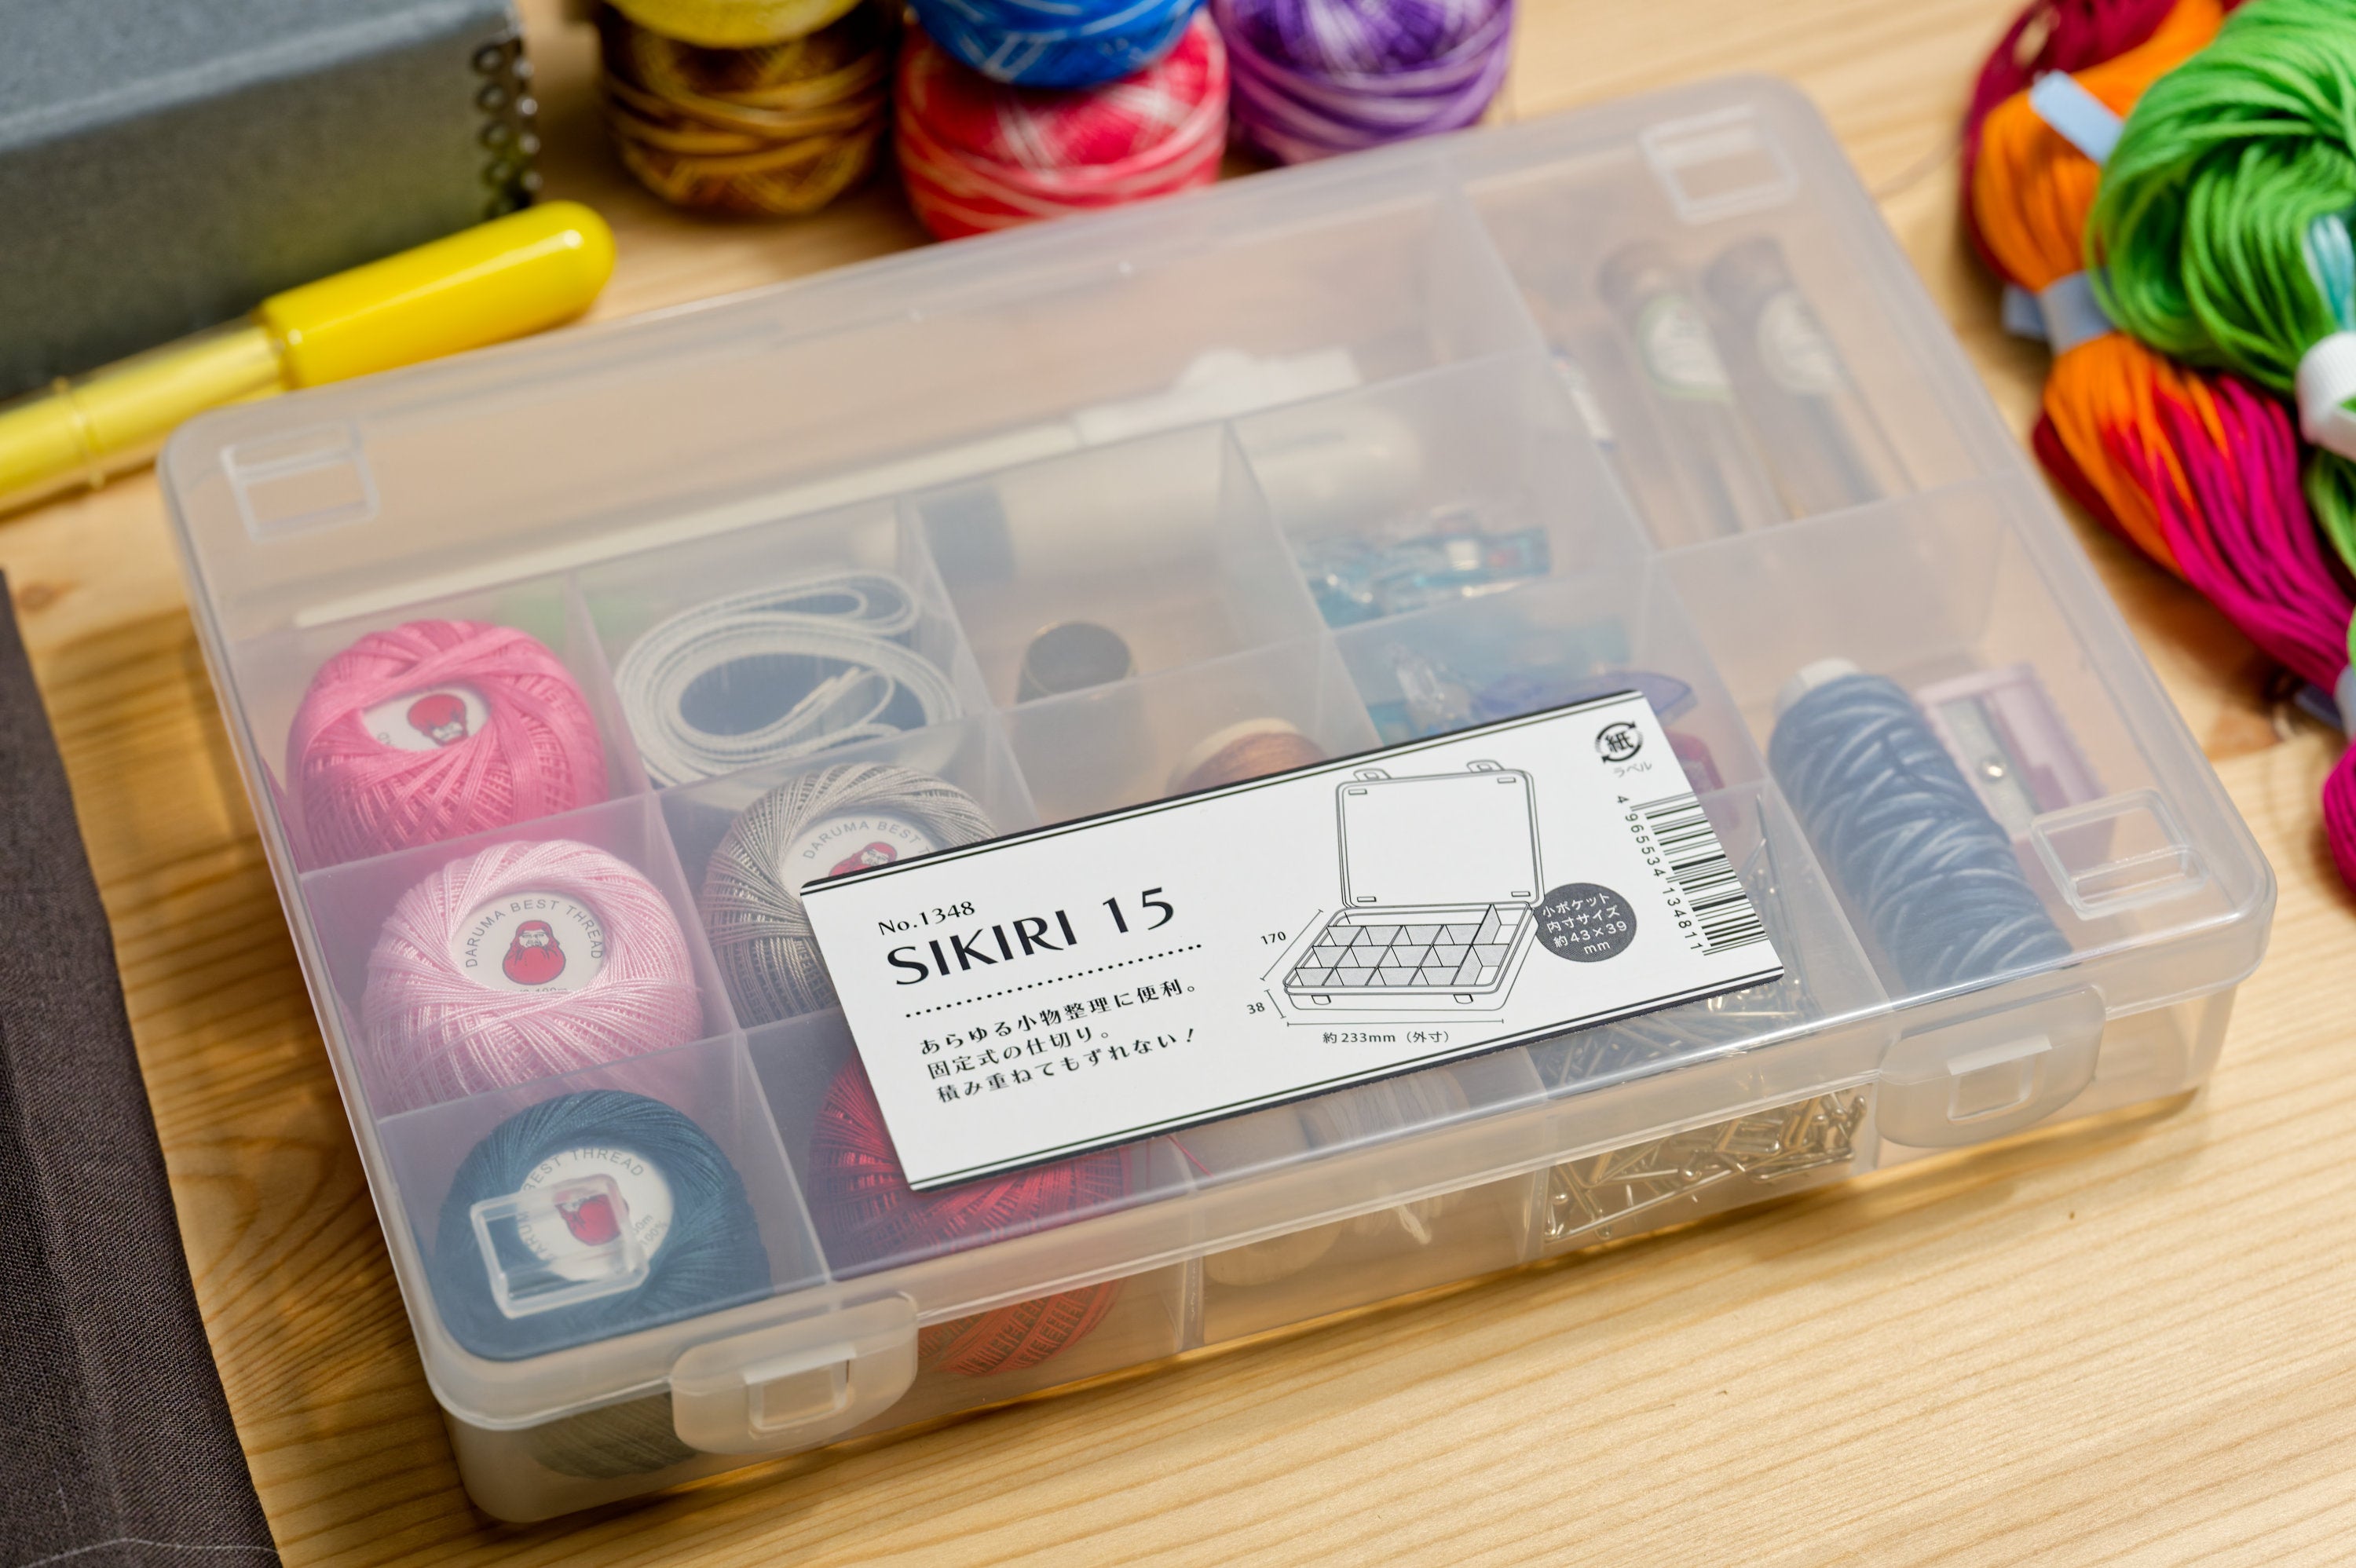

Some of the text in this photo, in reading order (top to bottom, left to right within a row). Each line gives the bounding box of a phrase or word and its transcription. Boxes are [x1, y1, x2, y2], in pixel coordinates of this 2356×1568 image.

[1604, 731, 1633, 753] 紙
[1613, 761, 1652, 777] ラベル
[803, 821, 921, 860] DARUMA BEST
[1616, 795, 1703, 950] 4 965534 134811
[877, 901, 976, 936] No.1348
[1542, 892, 1610, 918] 小ポケット
[1546, 905, 1620, 934] 内寸サイズ
[466, 899, 603, 967] DARUMA BEST THREAD
[887, 886, 1175, 985] SIKIRI 15
[1260, 931, 1286, 945] 170
[1583, 941, 1611, 954] mm
[920, 978, 1196, 1055] あらゆる小物整理に便利。
[1246, 1002, 1265, 1014] 38
[927, 1026, 1110, 1080] 固定式の仕切り。
[570, 1148, 644, 1176] THREAD
